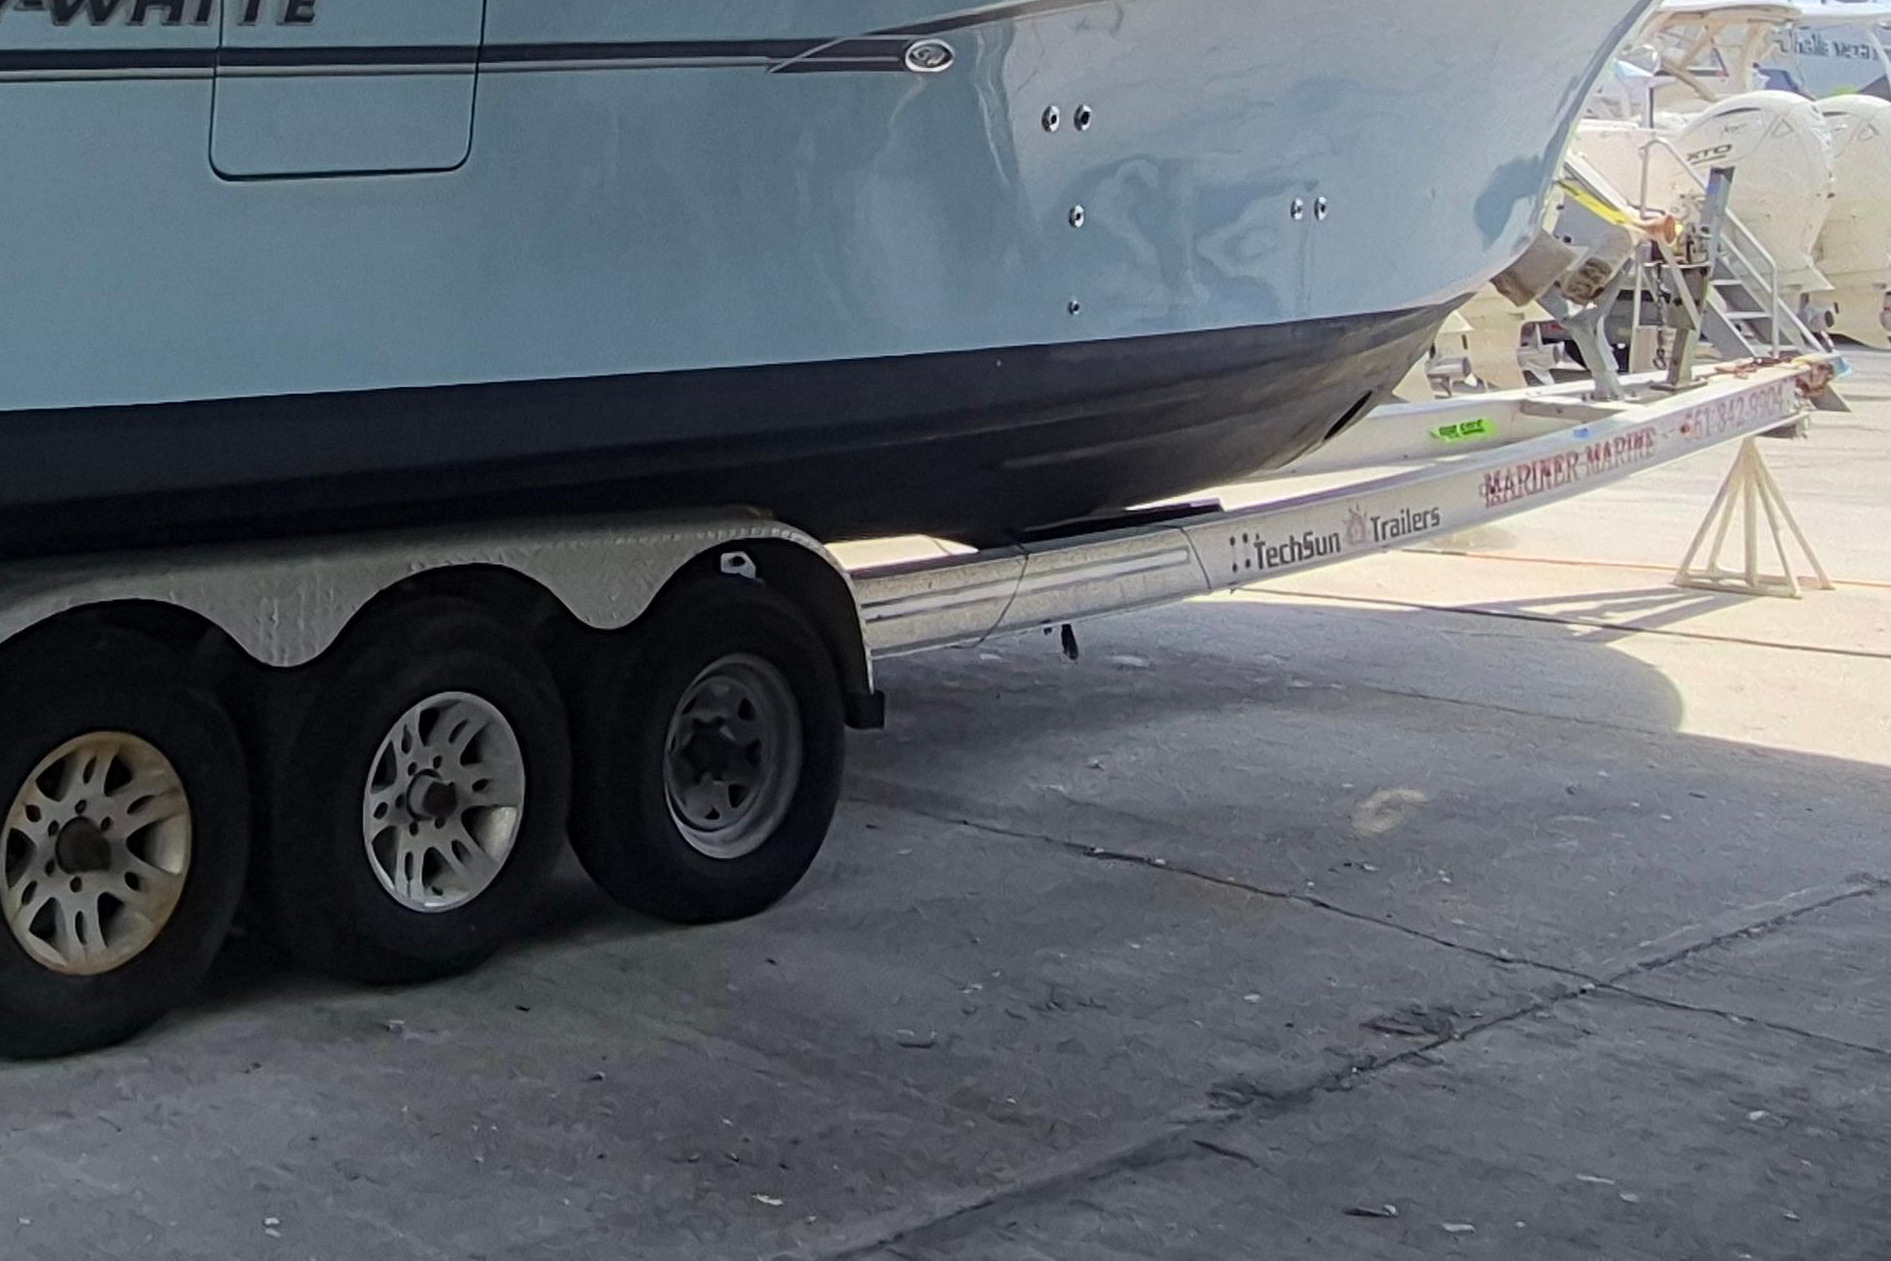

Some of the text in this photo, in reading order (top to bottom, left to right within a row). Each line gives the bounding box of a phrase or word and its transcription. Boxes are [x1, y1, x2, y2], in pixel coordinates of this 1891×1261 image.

[1685, 143, 1733, 162] XTO
[1482, 450, 1580, 508] MARINER
[1585, 426, 1657, 476] MARINE
[1253, 507, 1441, 570] TechSun Trailers
